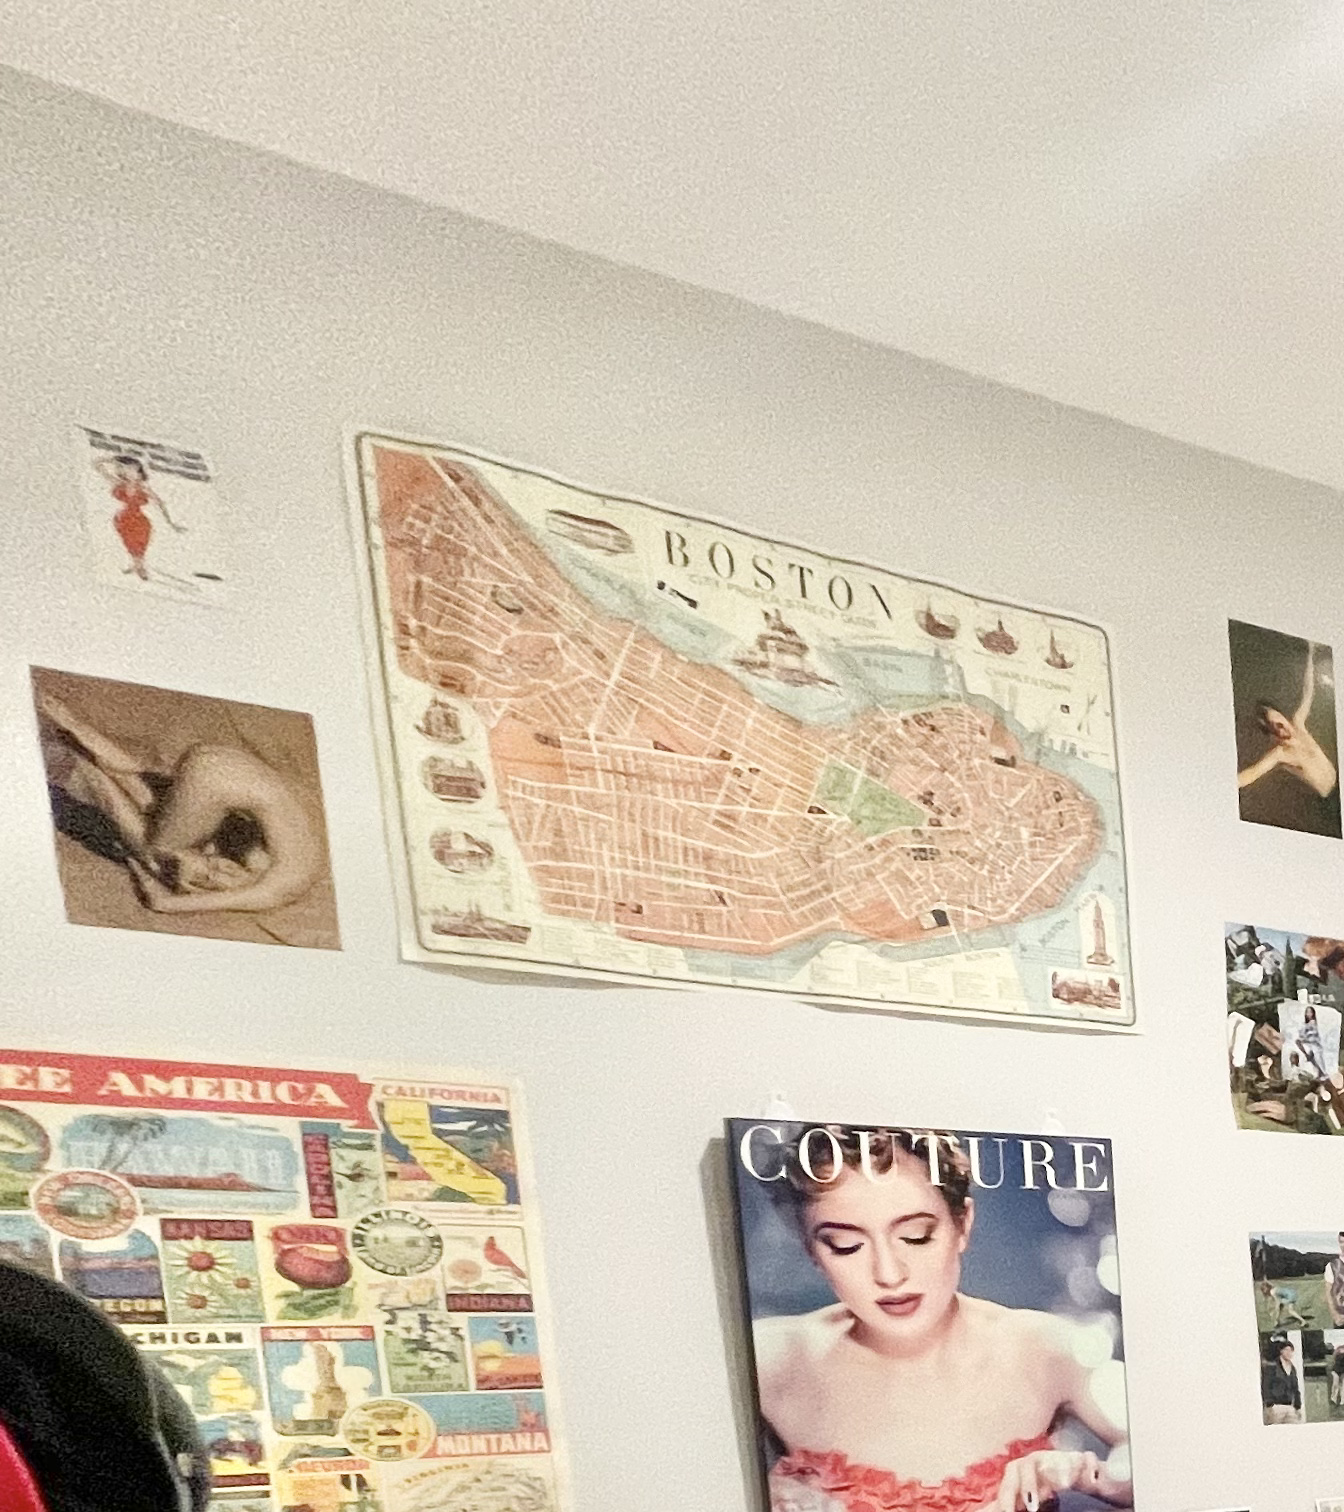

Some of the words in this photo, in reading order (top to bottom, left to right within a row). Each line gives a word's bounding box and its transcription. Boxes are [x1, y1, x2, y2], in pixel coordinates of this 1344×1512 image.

[664, 529, 894, 621] BOSTON
[98, 1071, 349, 1108] AMERICA
[382, 1084, 502, 1103] CALIFORNIA
[739, 1124, 1109, 1192] COUTURE
[129, 1331, 244, 1345] CHIGAN
[436, 1431, 550, 1456] MONTANA
